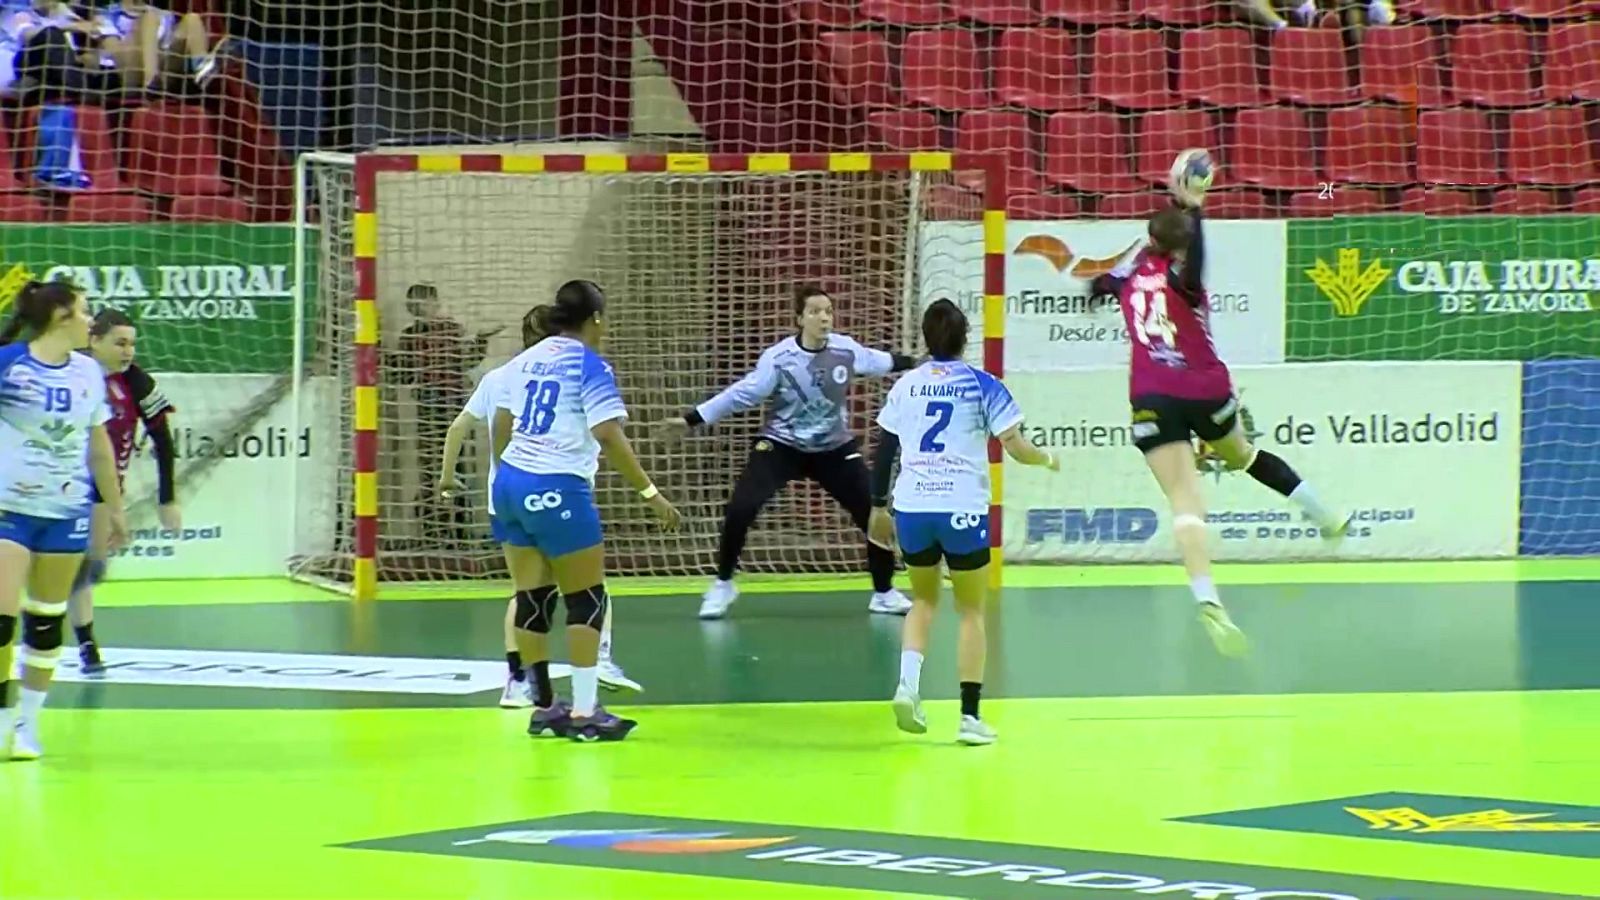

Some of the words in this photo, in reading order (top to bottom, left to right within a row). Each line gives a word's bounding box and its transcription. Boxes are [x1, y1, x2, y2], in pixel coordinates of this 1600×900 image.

[157, 265, 297, 297] RURAL
[1397, 260, 1493, 292] CAJA
[140, 299, 258, 319] ZAMORA
[1439, 293, 1476, 314] DE
[1484, 291, 1594, 314] ZAMORA
[1048, 322, 1106, 342] Desde
[1130, 290, 1177, 351] 14
[45, 387, 71, 412] 19
[920, 384, 966, 399] ALVAREZ
[515, 379, 561, 435] 18
[919, 401, 954, 454] 2
[1274, 414, 1315, 445] de
[1328, 410, 1499, 444] Valladolid
[523, 490, 562, 512] GO
[950, 512, 981, 530] GO
[1027, 507, 1159, 544] FMD
[1220, 527, 1248, 539] de
